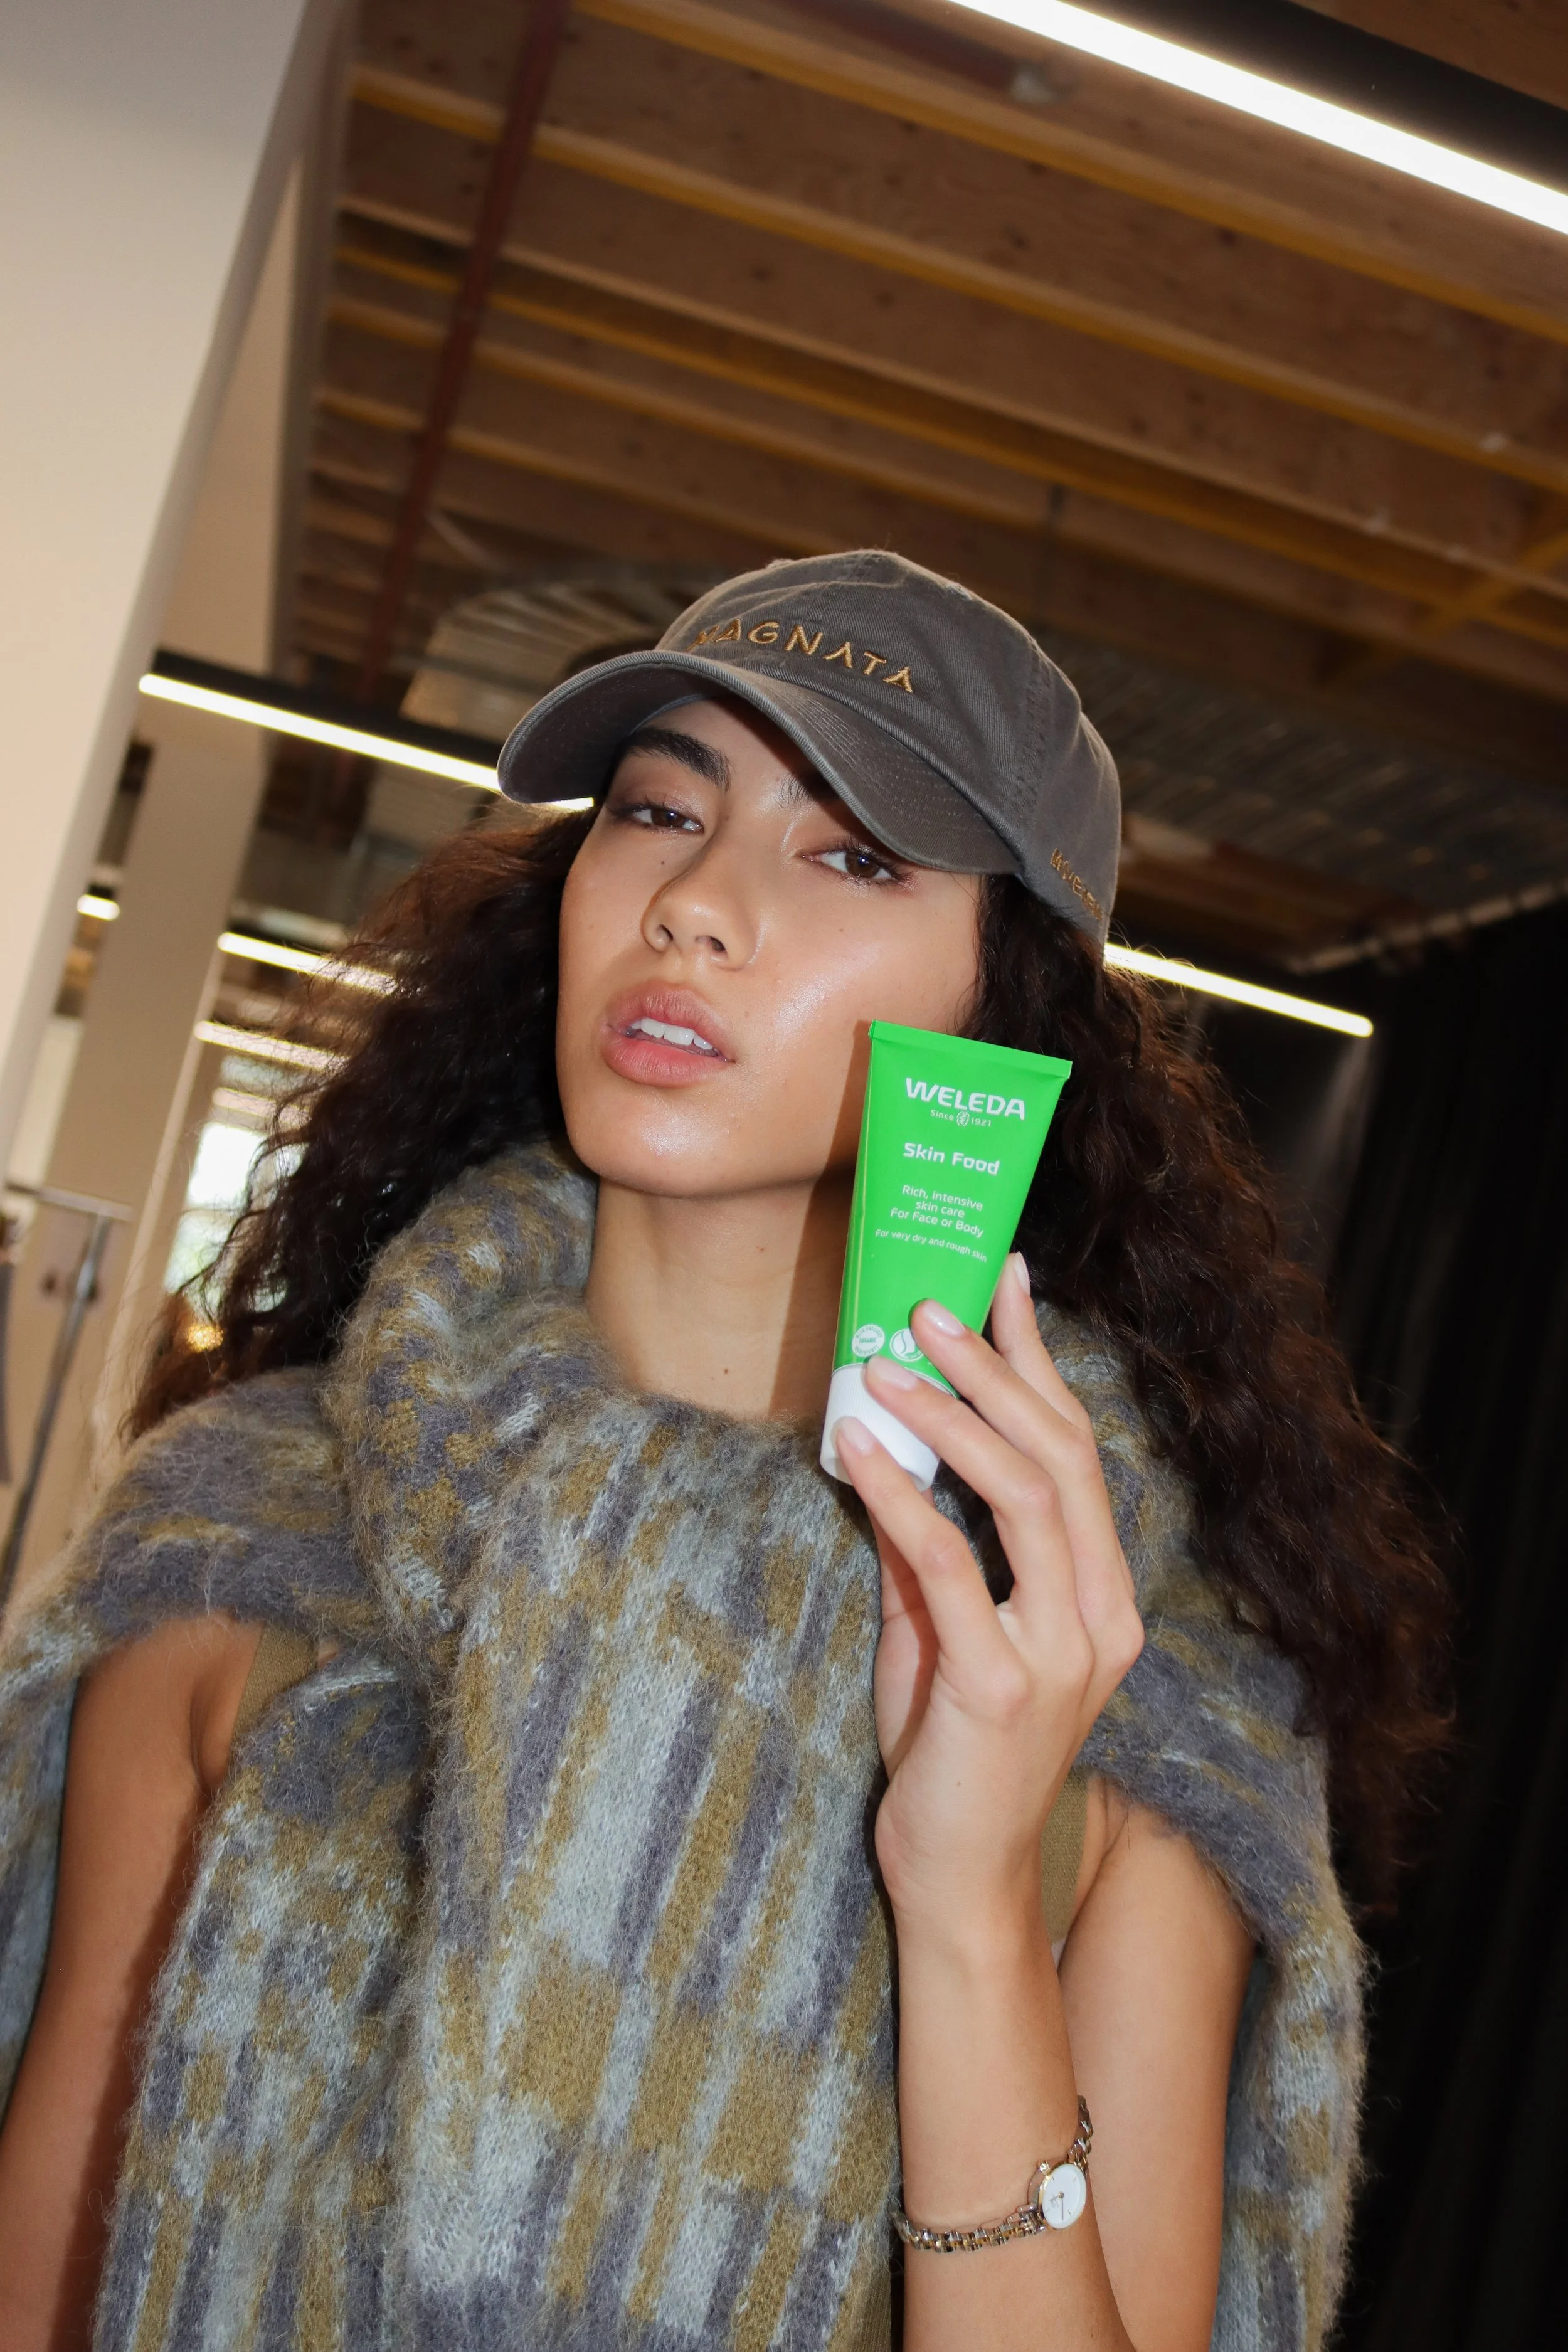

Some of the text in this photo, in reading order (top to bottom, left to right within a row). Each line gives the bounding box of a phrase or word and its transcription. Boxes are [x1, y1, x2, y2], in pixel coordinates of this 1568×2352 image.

[906, 1078, 1025, 1120] WELEDA
[930, 1109, 992, 1126] Since 1921
[903, 1142, 1000, 1176] Skin Food
[902, 1185, 983, 1211] Rich, intensive
[915, 1201, 965, 1218] skin care
[890, 1207, 983, 1238] For Face or Body
[875, 1229, 987, 1263] For very dry and rough skin
